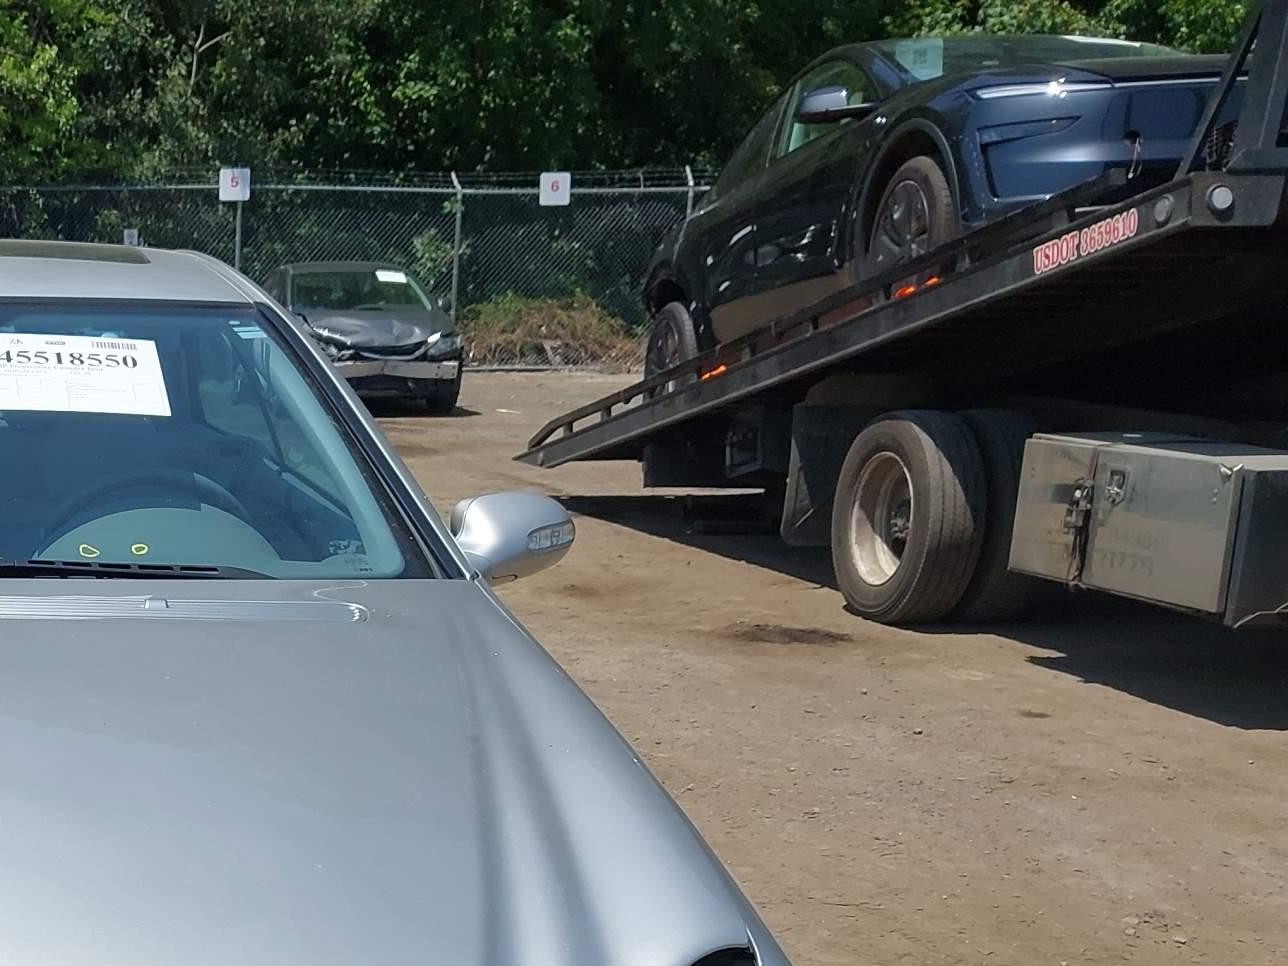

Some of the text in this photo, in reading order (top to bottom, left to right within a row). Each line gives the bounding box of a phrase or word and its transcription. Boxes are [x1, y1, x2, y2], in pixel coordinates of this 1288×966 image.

[230, 176, 239, 188] 5
[551, 180, 560, 192] 6
[1033, 230, 1079, 274] USDOT
